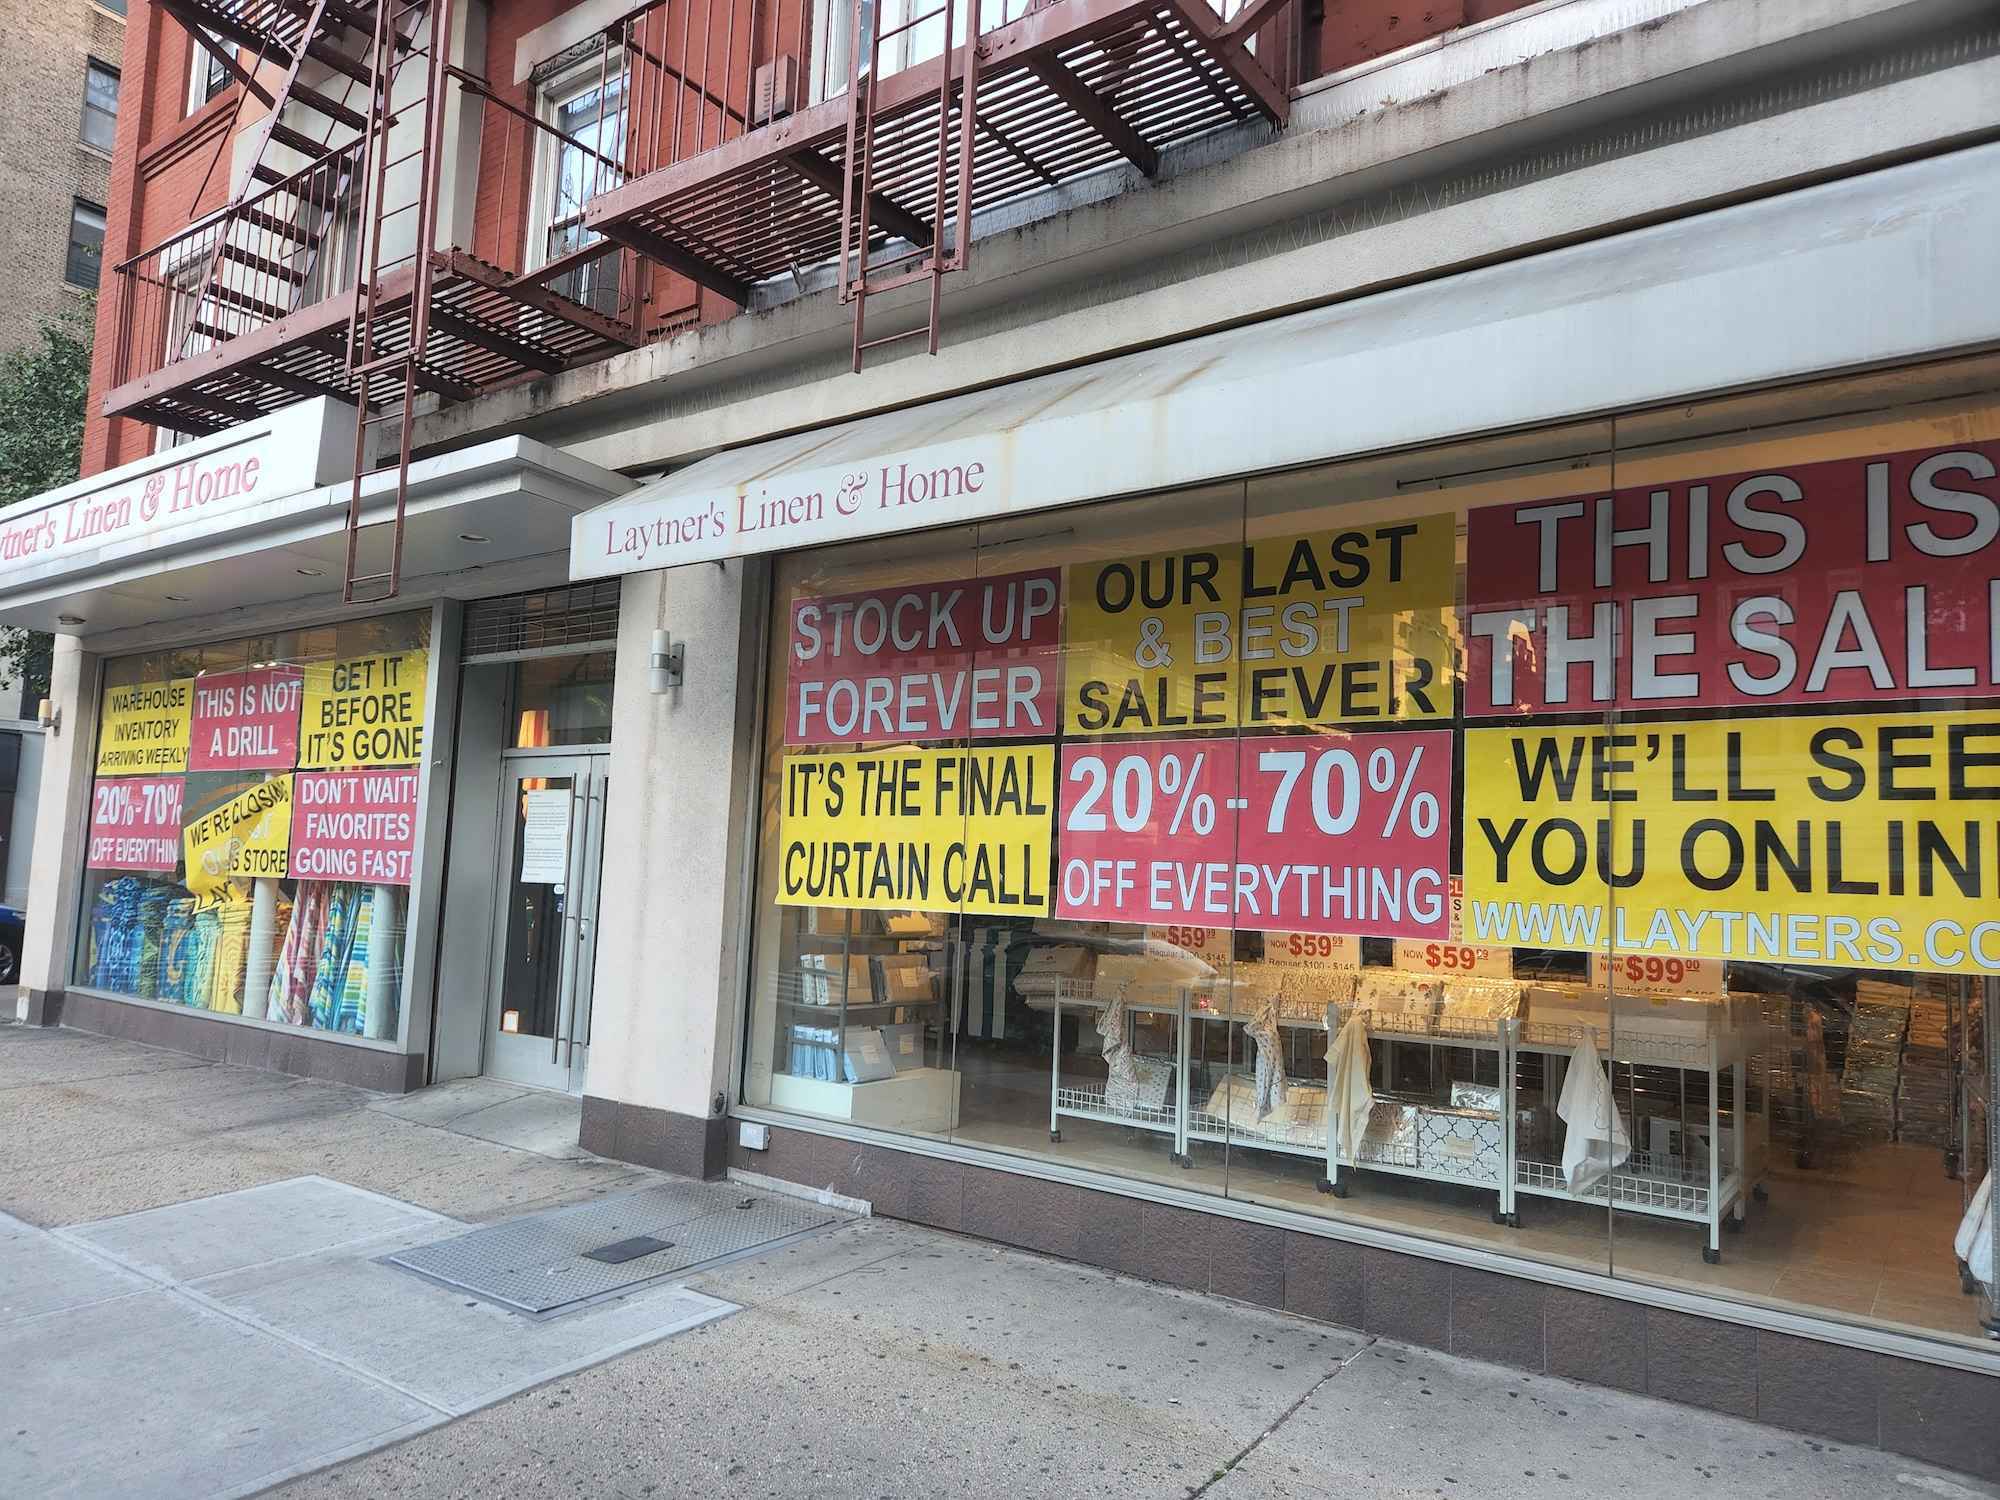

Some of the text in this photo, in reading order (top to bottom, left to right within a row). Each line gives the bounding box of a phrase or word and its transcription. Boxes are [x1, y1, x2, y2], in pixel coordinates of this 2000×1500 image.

[62, 497, 131, 544] Linen
[139, 475, 165, 522] &
[168, 456, 260, 513] Home
[606, 461, 984, 560] Laytner's Linen & Home
[1515, 451, 2000, 593] THIS IS
[1097, 524, 1418, 613] OUR LAST
[794, 578, 1057, 661] STOCK UP
[1134, 597, 1364, 670] & BEST
[1470, 577, 2000, 706] THE SAL
[333, 657, 403, 692] GET IT
[1077, 657, 1437, 729] SALE EVER
[112, 688, 185, 713] WAREHOUSE
[198, 679, 304, 718] THIS IS NOT
[321, 692, 412, 728] BEFORE
[798, 666, 1043, 737] FOREVER
[114, 719, 180, 741] INVENTORY
[210, 725, 278, 757] A DRILL
[307, 726, 424, 763] IT'S GONE
[100, 747, 189, 766] ARRIVING WEEKLY
[1511, 723, 2000, 802] WE'LL SEE
[302, 776, 417, 805] DON'T WAIT!
[789, 755, 1046, 818] IT'S THE FINAL
[191, 808, 230, 848] WE'RE
[306, 813, 410, 841] FAVORITES
[92, 838, 114, 861] OFF
[244, 849, 286, 872] STORE
[296, 848, 356, 875] GOING
[1478, 818, 2000, 898] YOU ONLIN
[785, 841, 1044, 905] CURTAIN CALL
[1063, 858, 1443, 924] OFF EVERYTHING
[1271, 940, 1287, 948] NOW
[1289, 933, 1331, 958] $59
[1403, 950, 1424, 959] NOW
[1426, 943, 1475, 970] $59
[1626, 955, 1684, 984] $99
